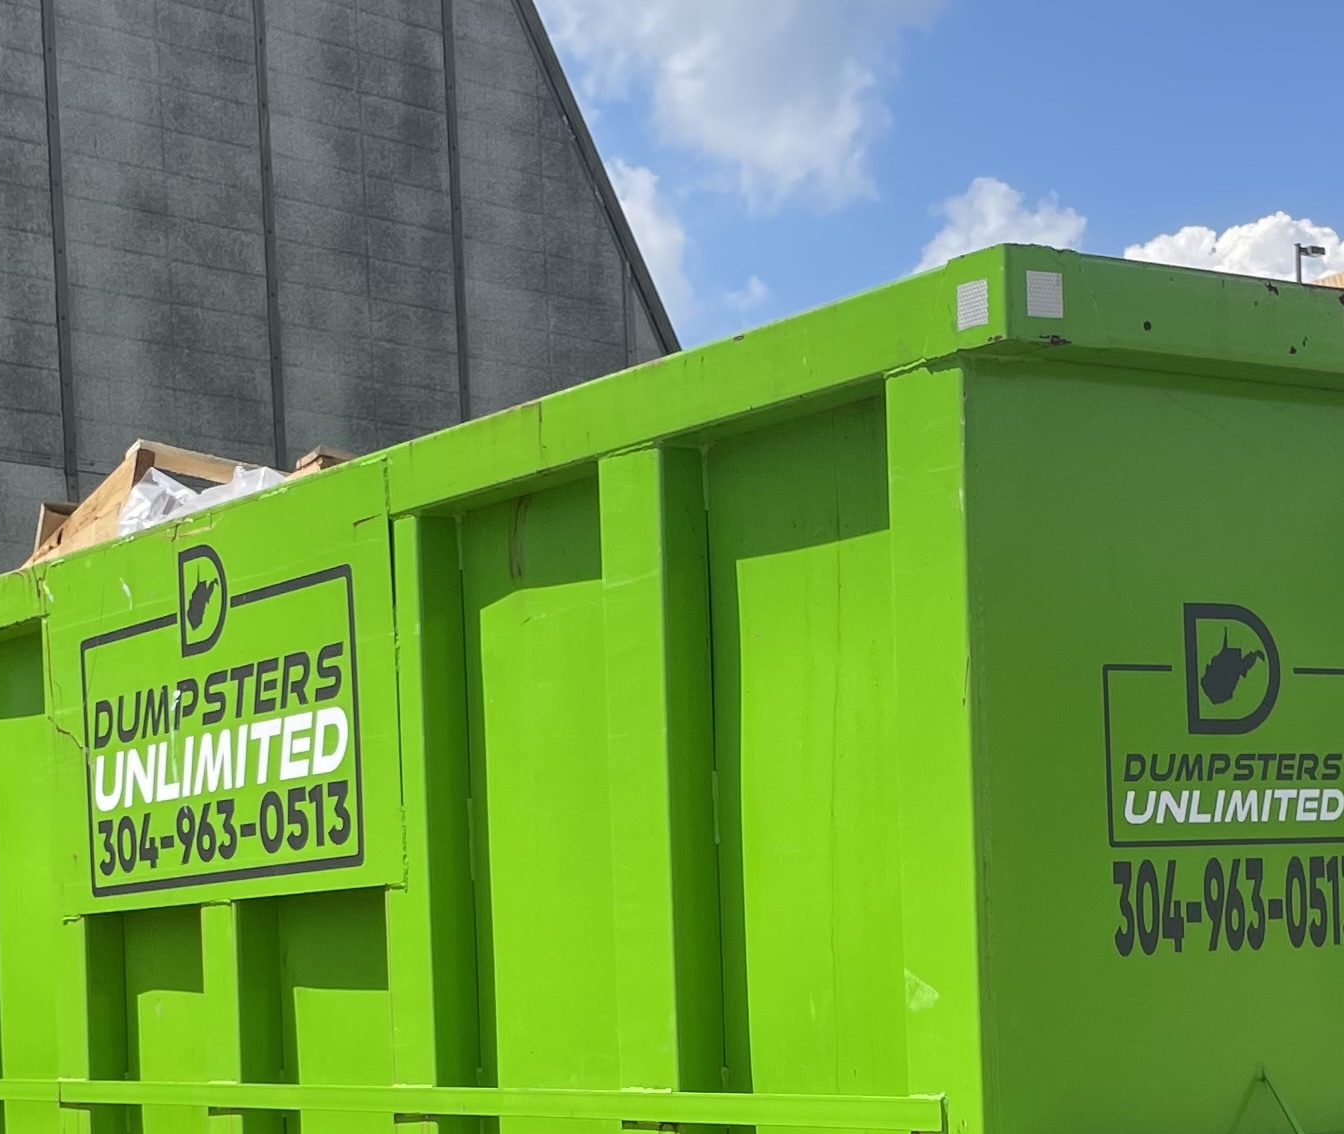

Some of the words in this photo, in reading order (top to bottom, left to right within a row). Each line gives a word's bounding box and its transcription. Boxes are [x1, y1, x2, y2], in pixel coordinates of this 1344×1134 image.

[94, 642, 343, 749] DUMPSTERS
[95, 707, 349, 812] UNLIMITED
[1124, 753, 1342, 782] DUMPSTERS
[1124, 789, 1344, 824] UNLIMITED
[97, 780, 351, 876] 304-963-0513
